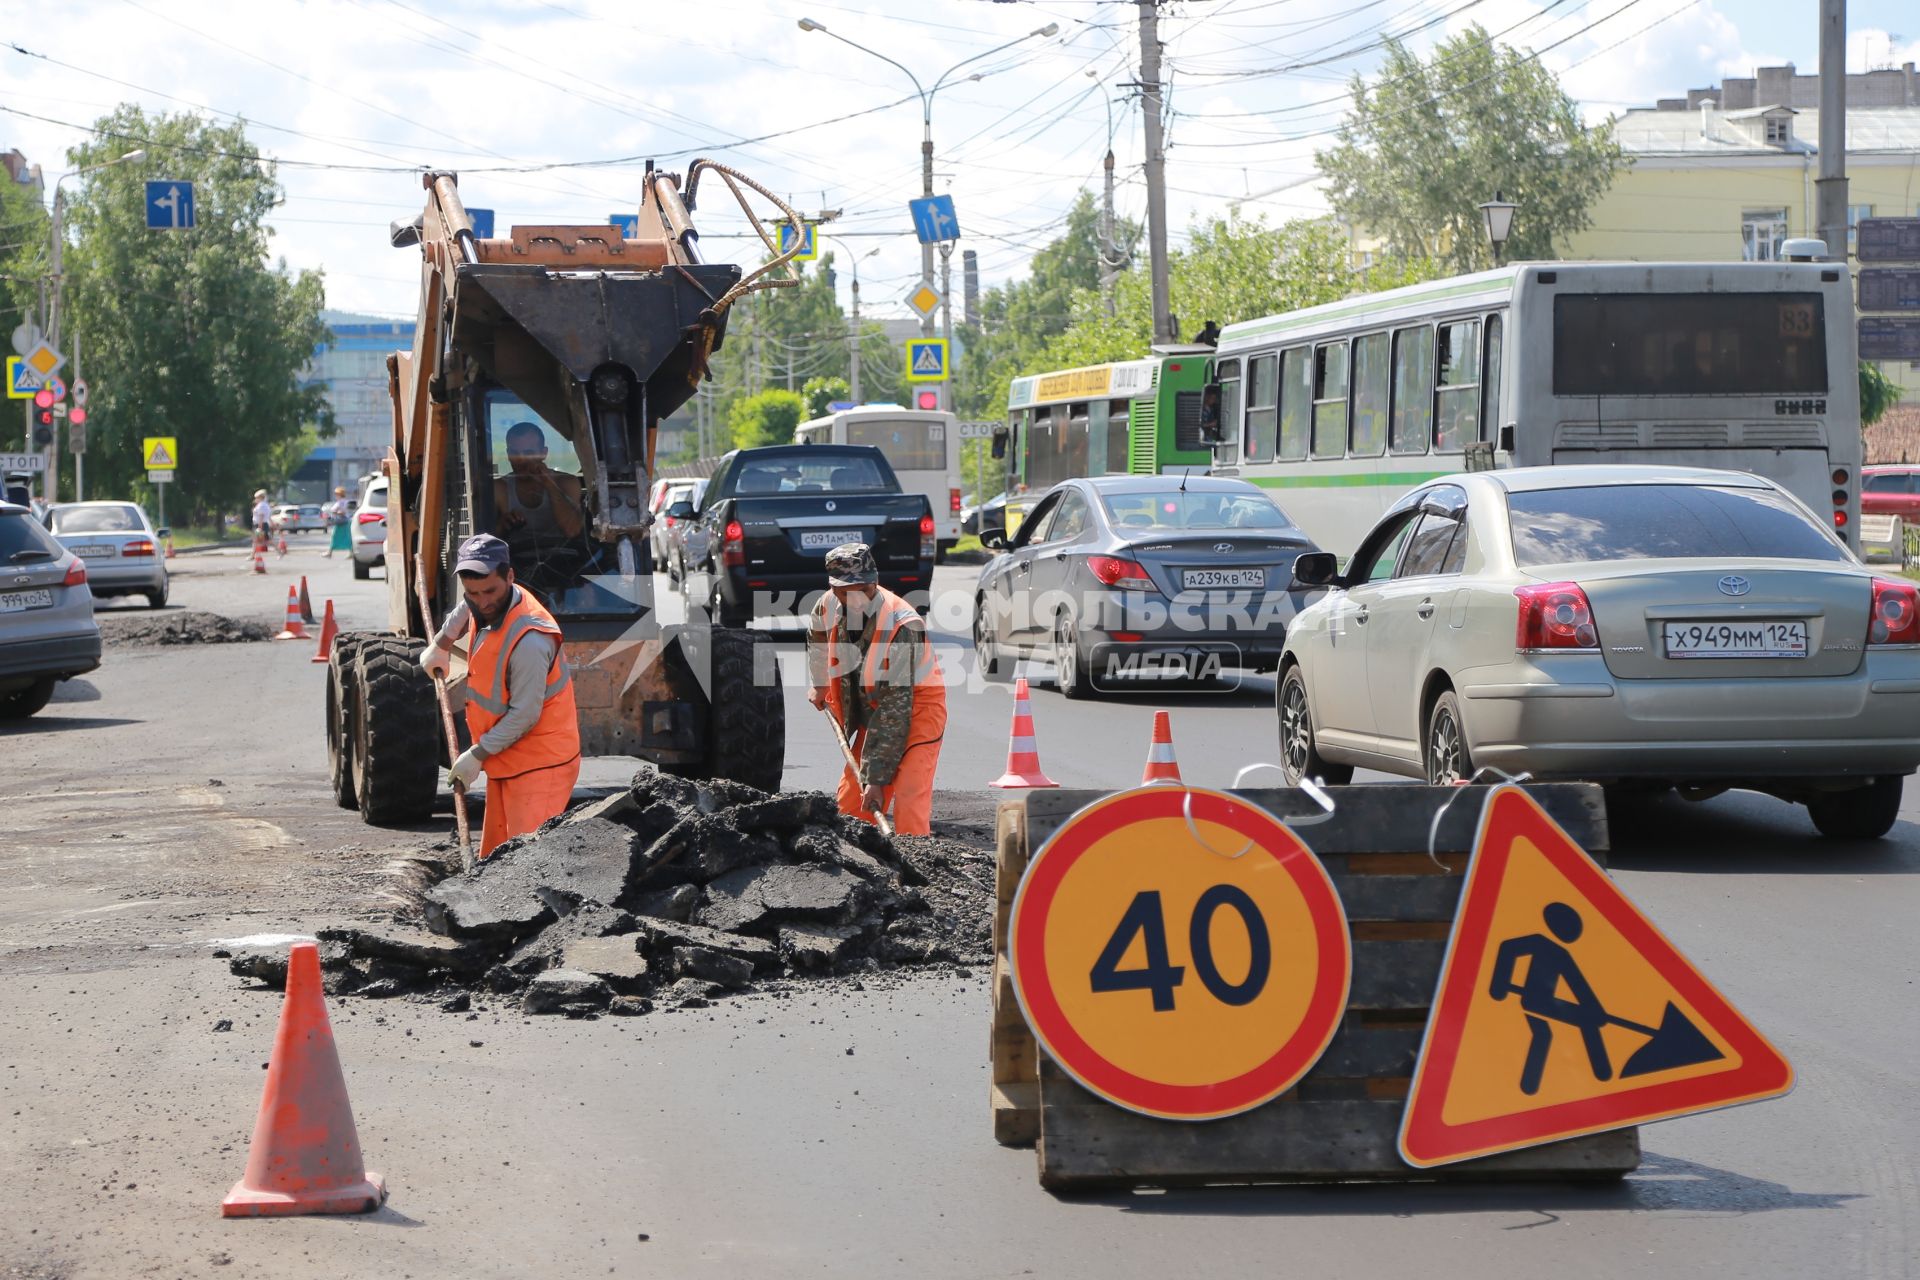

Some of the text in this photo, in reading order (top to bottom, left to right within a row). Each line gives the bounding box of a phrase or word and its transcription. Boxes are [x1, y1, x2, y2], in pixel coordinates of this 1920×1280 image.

[1782, 310, 1809, 331] 83
[930, 427, 943, 439] 77
[1089, 883, 1271, 1012] 40
